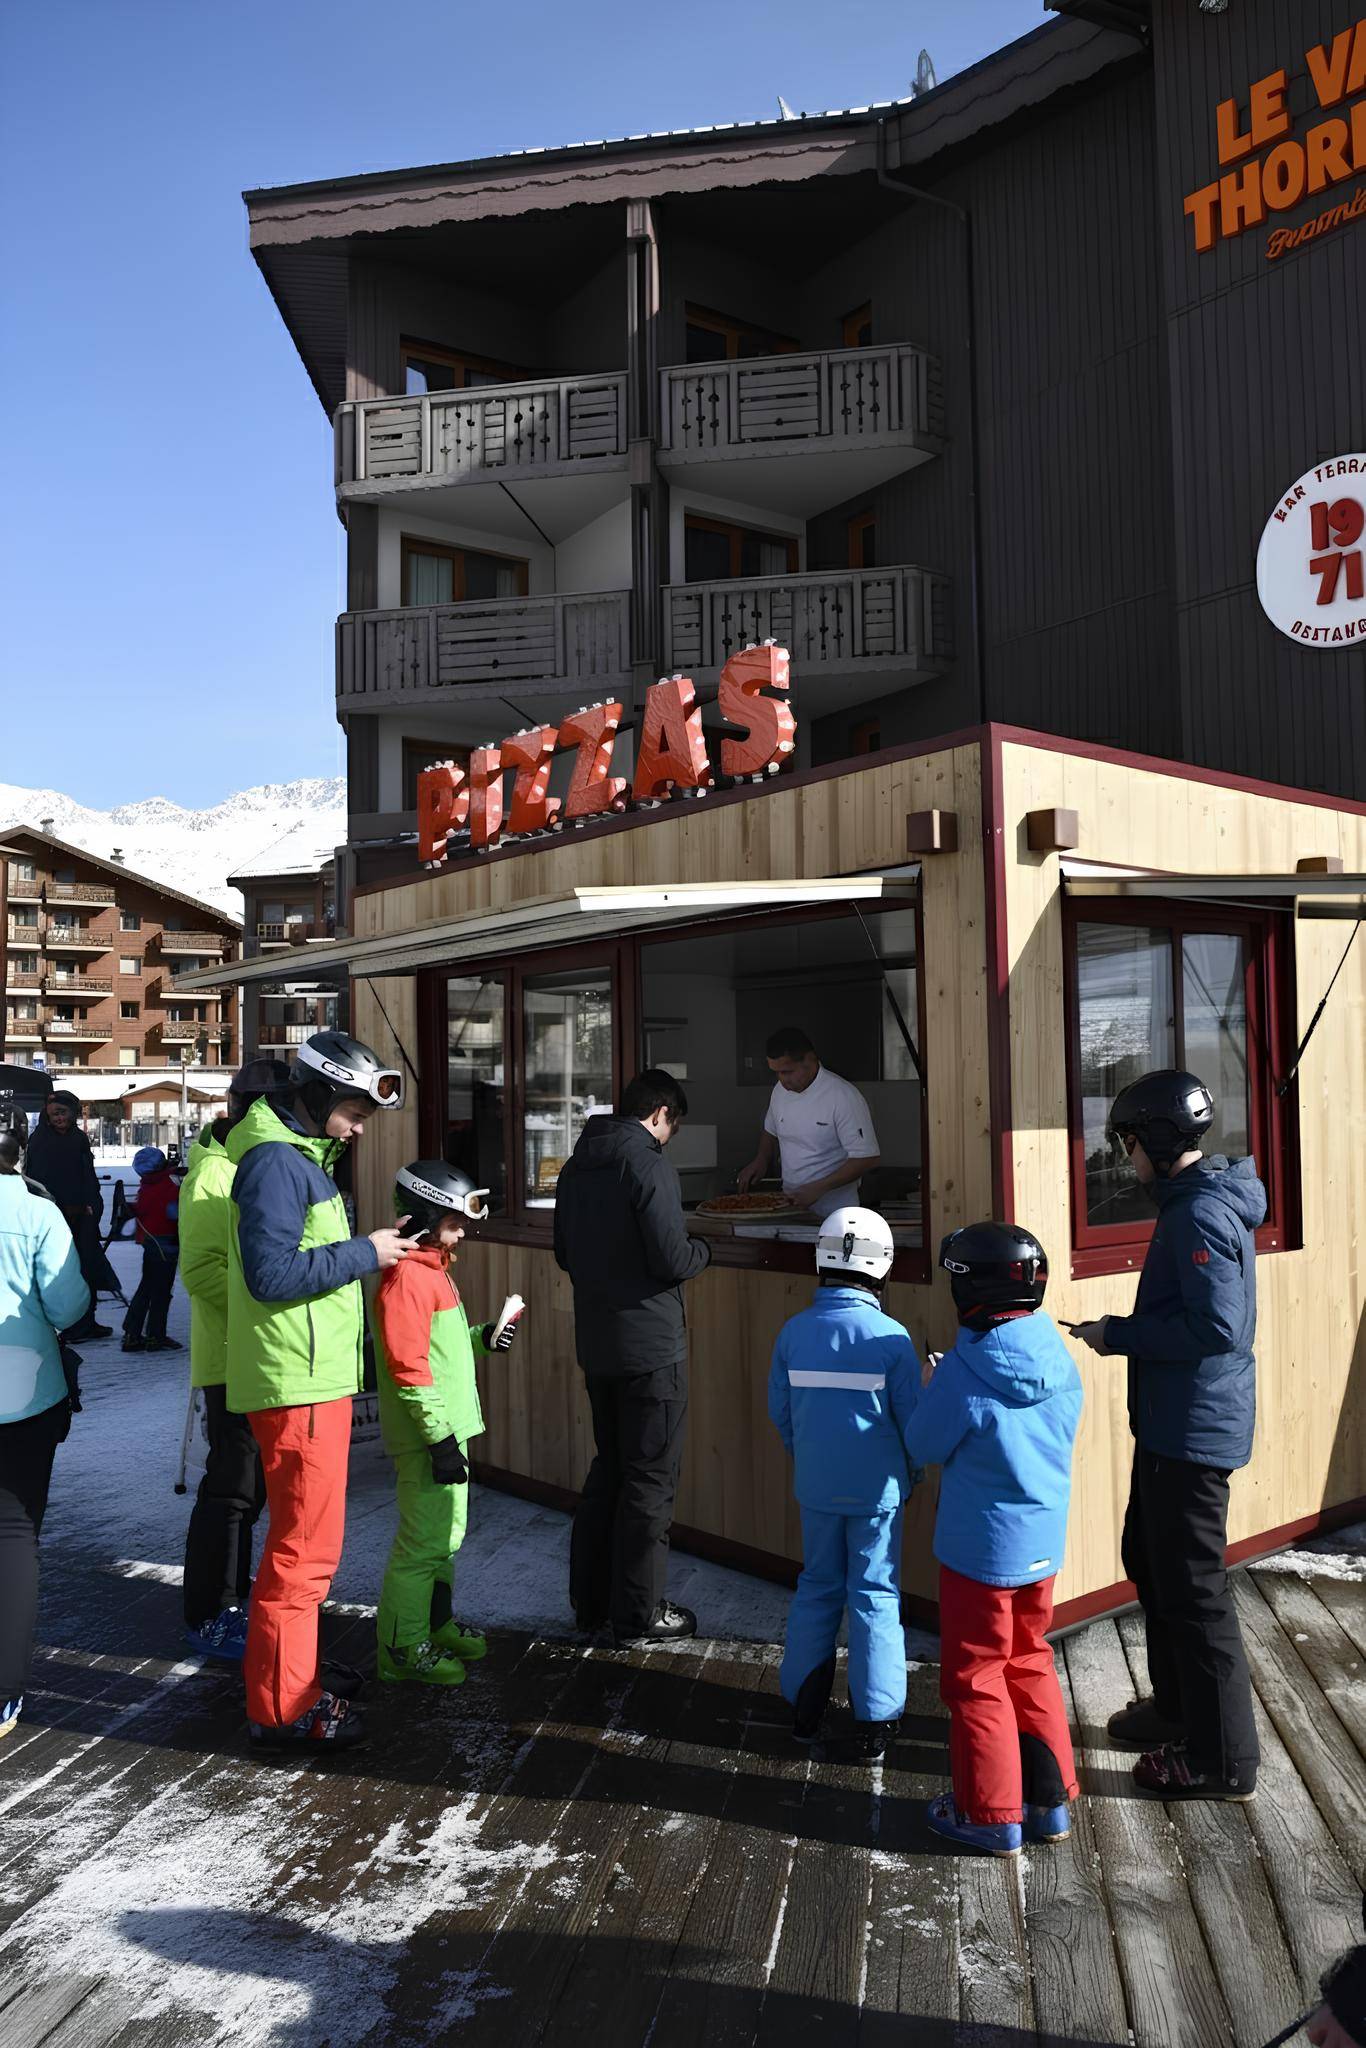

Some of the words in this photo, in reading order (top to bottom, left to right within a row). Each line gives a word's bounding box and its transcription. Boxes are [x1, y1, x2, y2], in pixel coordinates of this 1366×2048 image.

[1216, 69, 1290, 167] LE
[1310, 497, 1364, 551] 19
[1310, 551, 1364, 606] 71
[416, 644, 797, 863] PIZZAS
